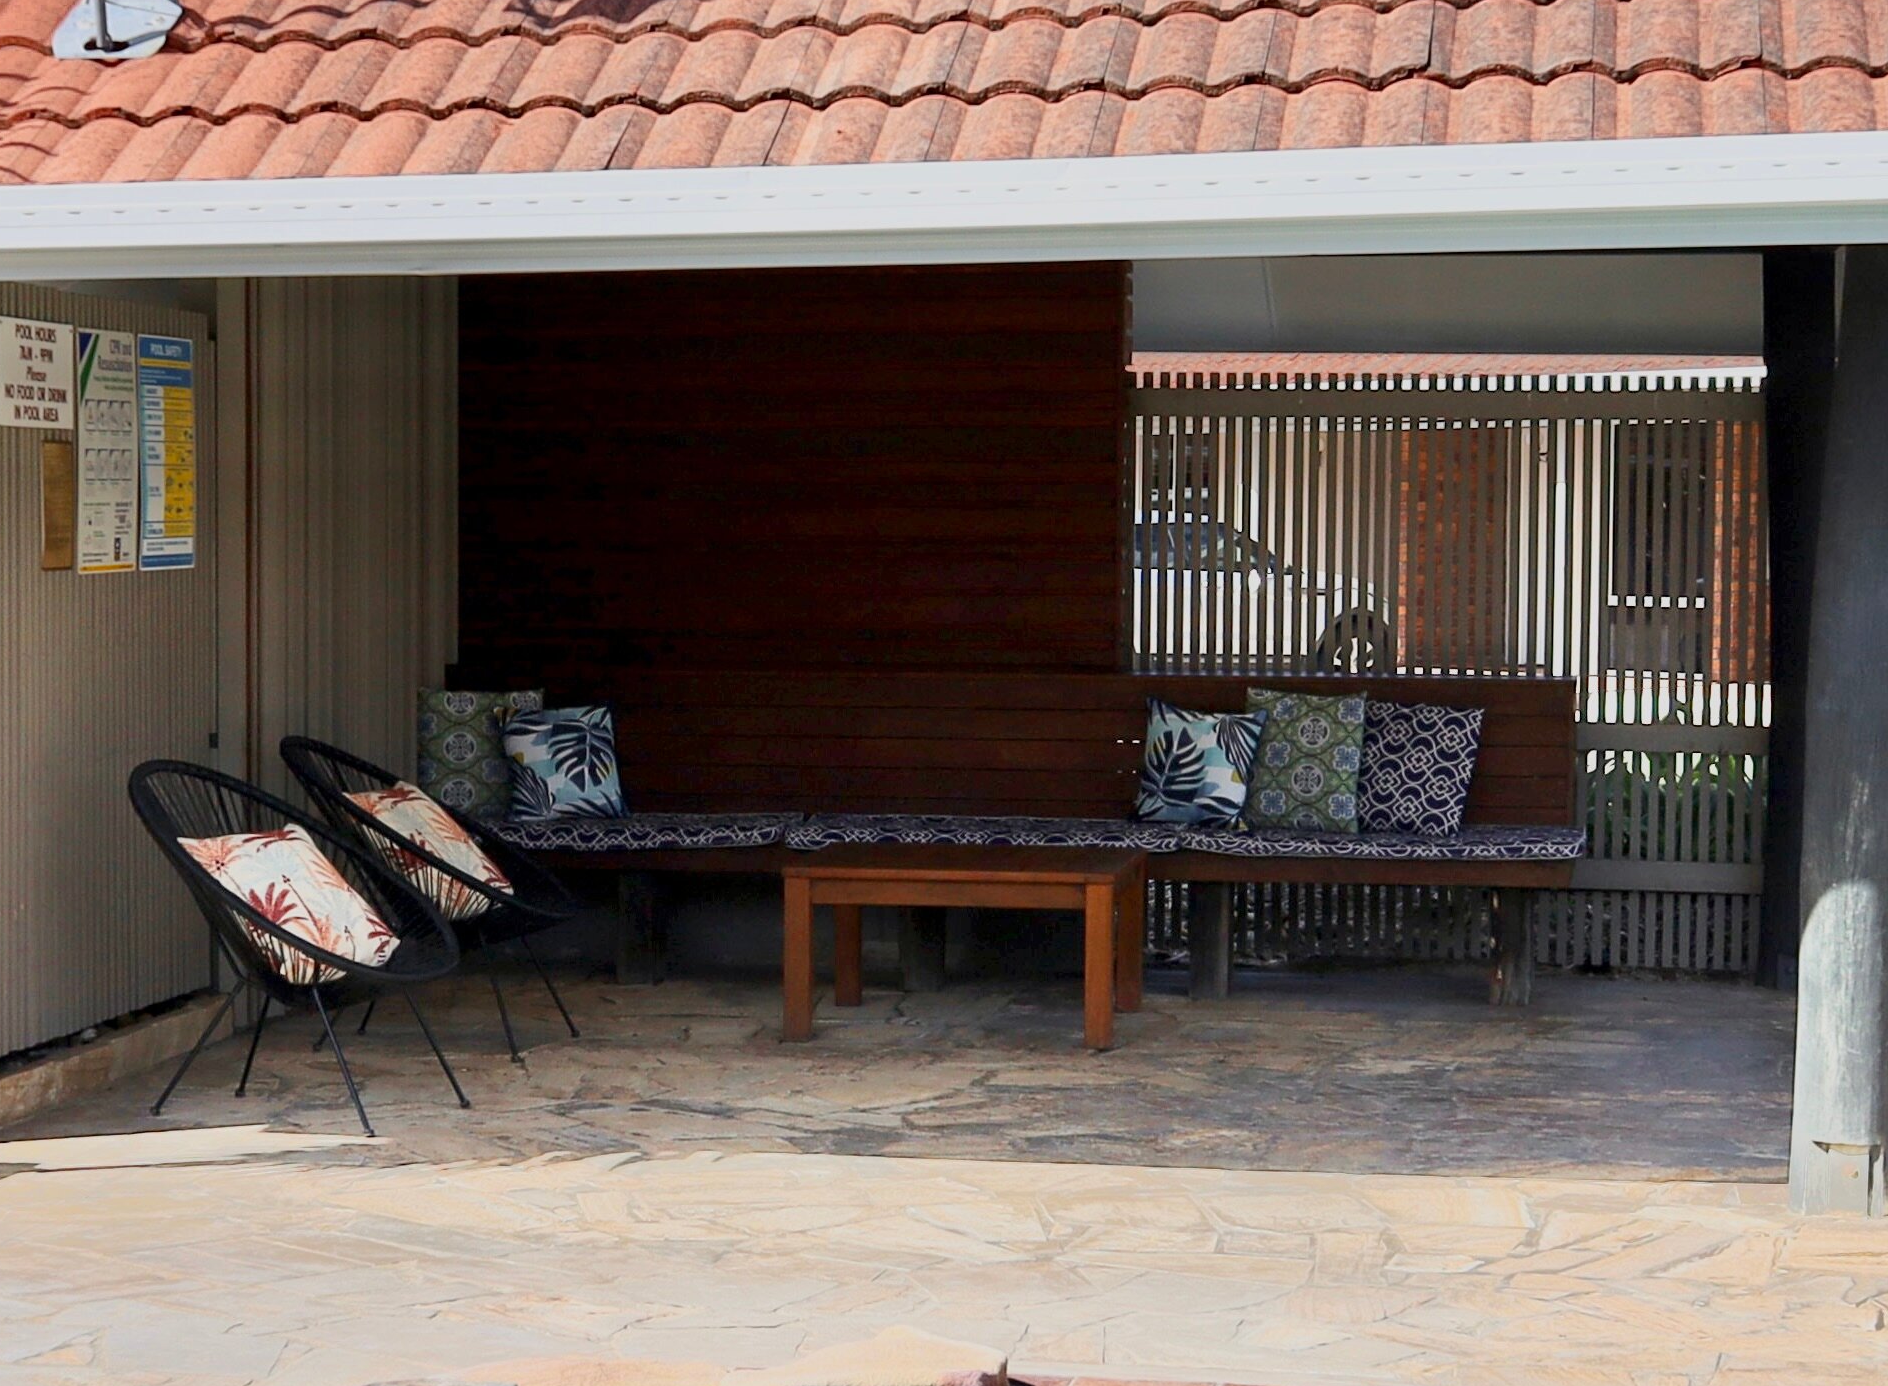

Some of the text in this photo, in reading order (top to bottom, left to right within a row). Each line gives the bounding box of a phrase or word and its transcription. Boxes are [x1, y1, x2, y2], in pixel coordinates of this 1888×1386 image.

[15, 323, 56, 343] POOL HOURS
[150, 343, 182, 358] POOL SAFETY
[26, 366, 46, 382] Please
[5, 383, 67, 404] NO FOOD OR DRINK
[14, 405, 59, 422] IN POOL AREA
